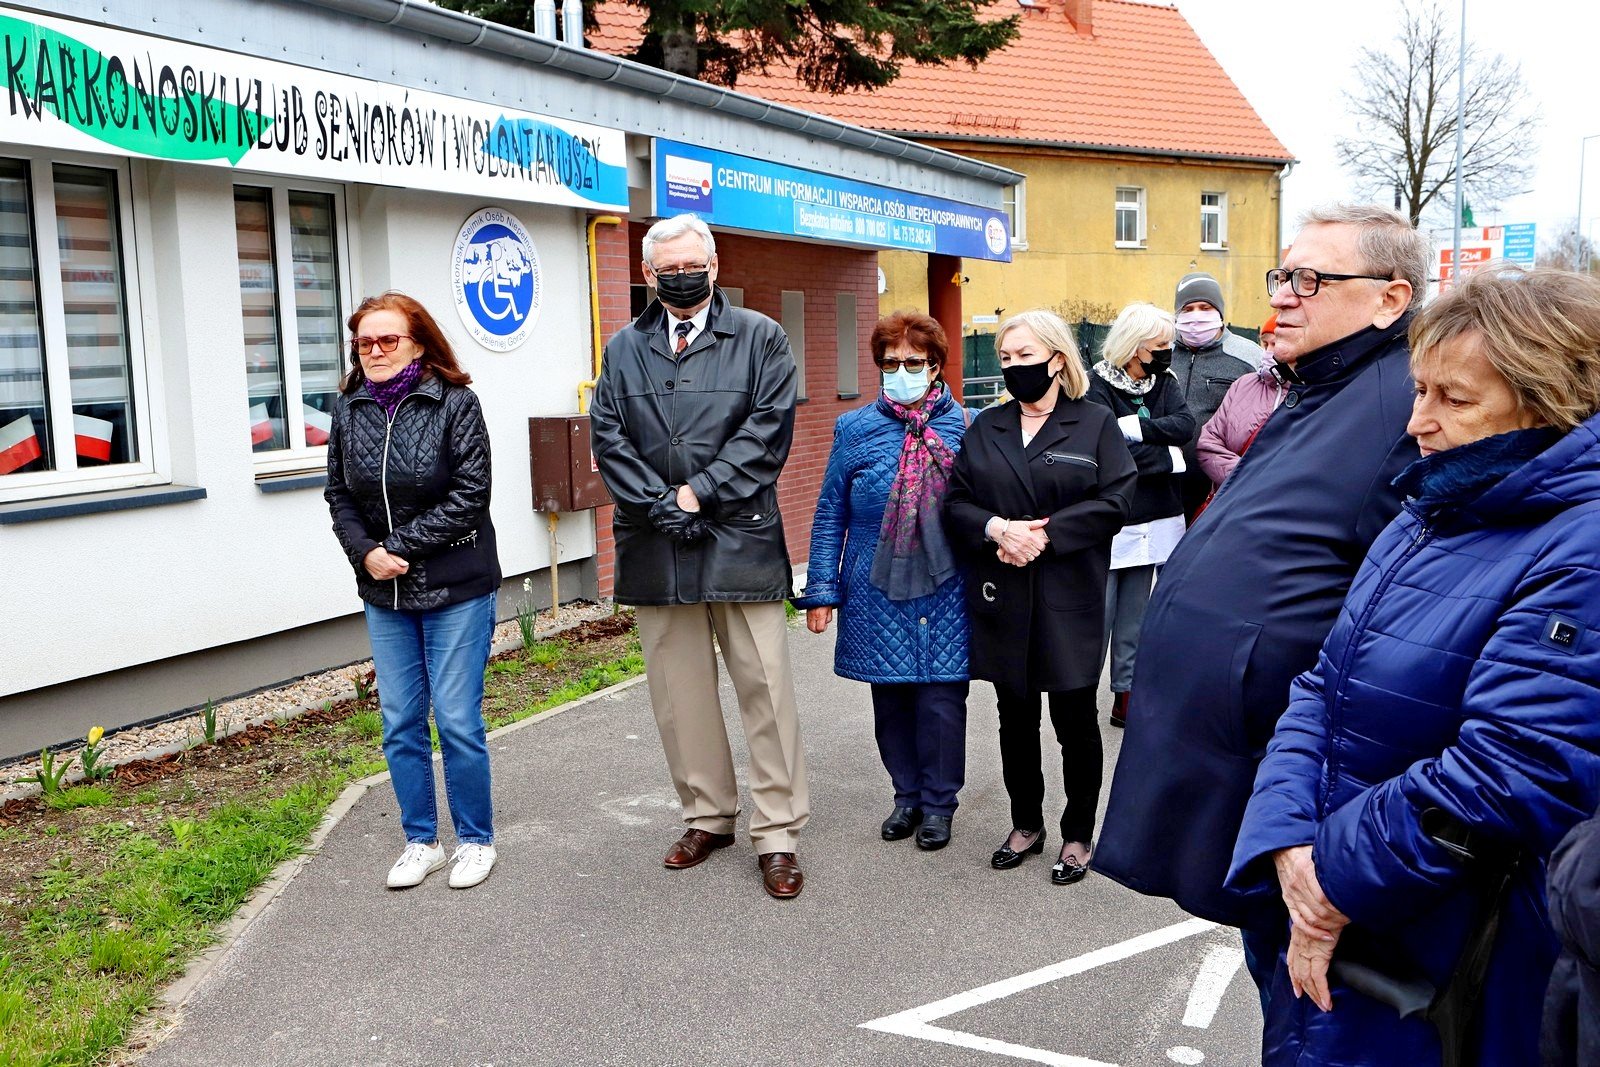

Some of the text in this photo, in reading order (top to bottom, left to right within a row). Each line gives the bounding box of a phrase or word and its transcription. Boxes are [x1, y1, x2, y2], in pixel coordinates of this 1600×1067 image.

[5, 34, 601, 192] KARKONOSKI KLUB SENIORÓW I WOLONTARIUSZY
[717, 167, 983, 232] CENTRUM INFORMACJI I WSPARCIA OSÓB NIEPEŁNOSPRAWNYCH
[453, 211, 540, 309] Karkonoski Sejmik Osób Niepełnosprawnych
[474, 328, 480, 336] w
[480, 333, 507, 350] Jeleniej
